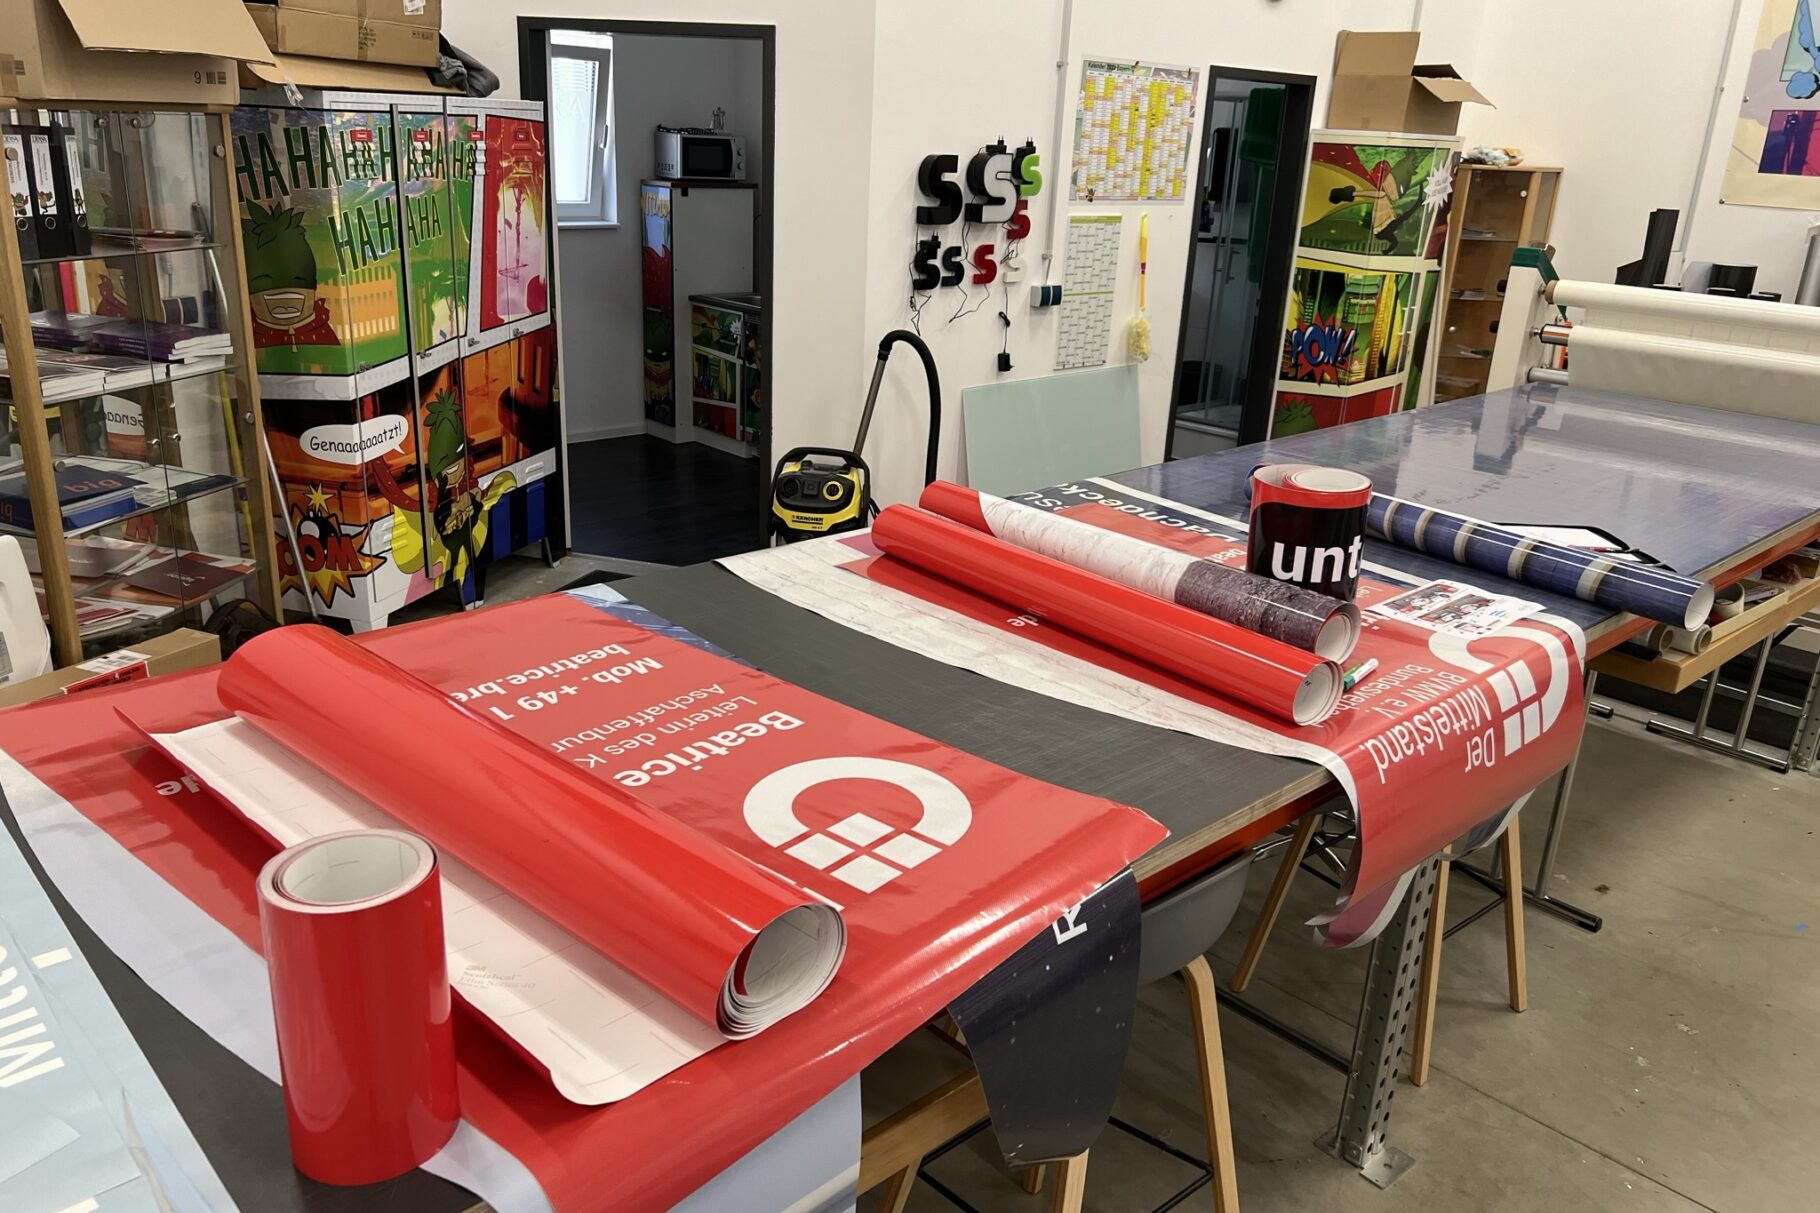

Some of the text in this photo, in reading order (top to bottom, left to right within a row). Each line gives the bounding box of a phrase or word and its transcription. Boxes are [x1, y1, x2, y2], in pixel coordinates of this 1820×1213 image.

[917, 154, 963, 225] S
[965, 152, 1018, 223] S
[1019, 155, 1043, 196] S
[941, 246, 965, 287] S
[973, 244, 997, 285] S
[1291, 324, 1356, 367] POW!
[64, 479, 122, 493] big
[582, 657, 664, 686] Mob.
[517, 683, 580, 712] +49
[662, 695, 758, 736] Leiterin
[604, 732, 657, 757] des
[614, 710, 805, 788] Beatrice
[1465, 727, 1496, 774] Der
